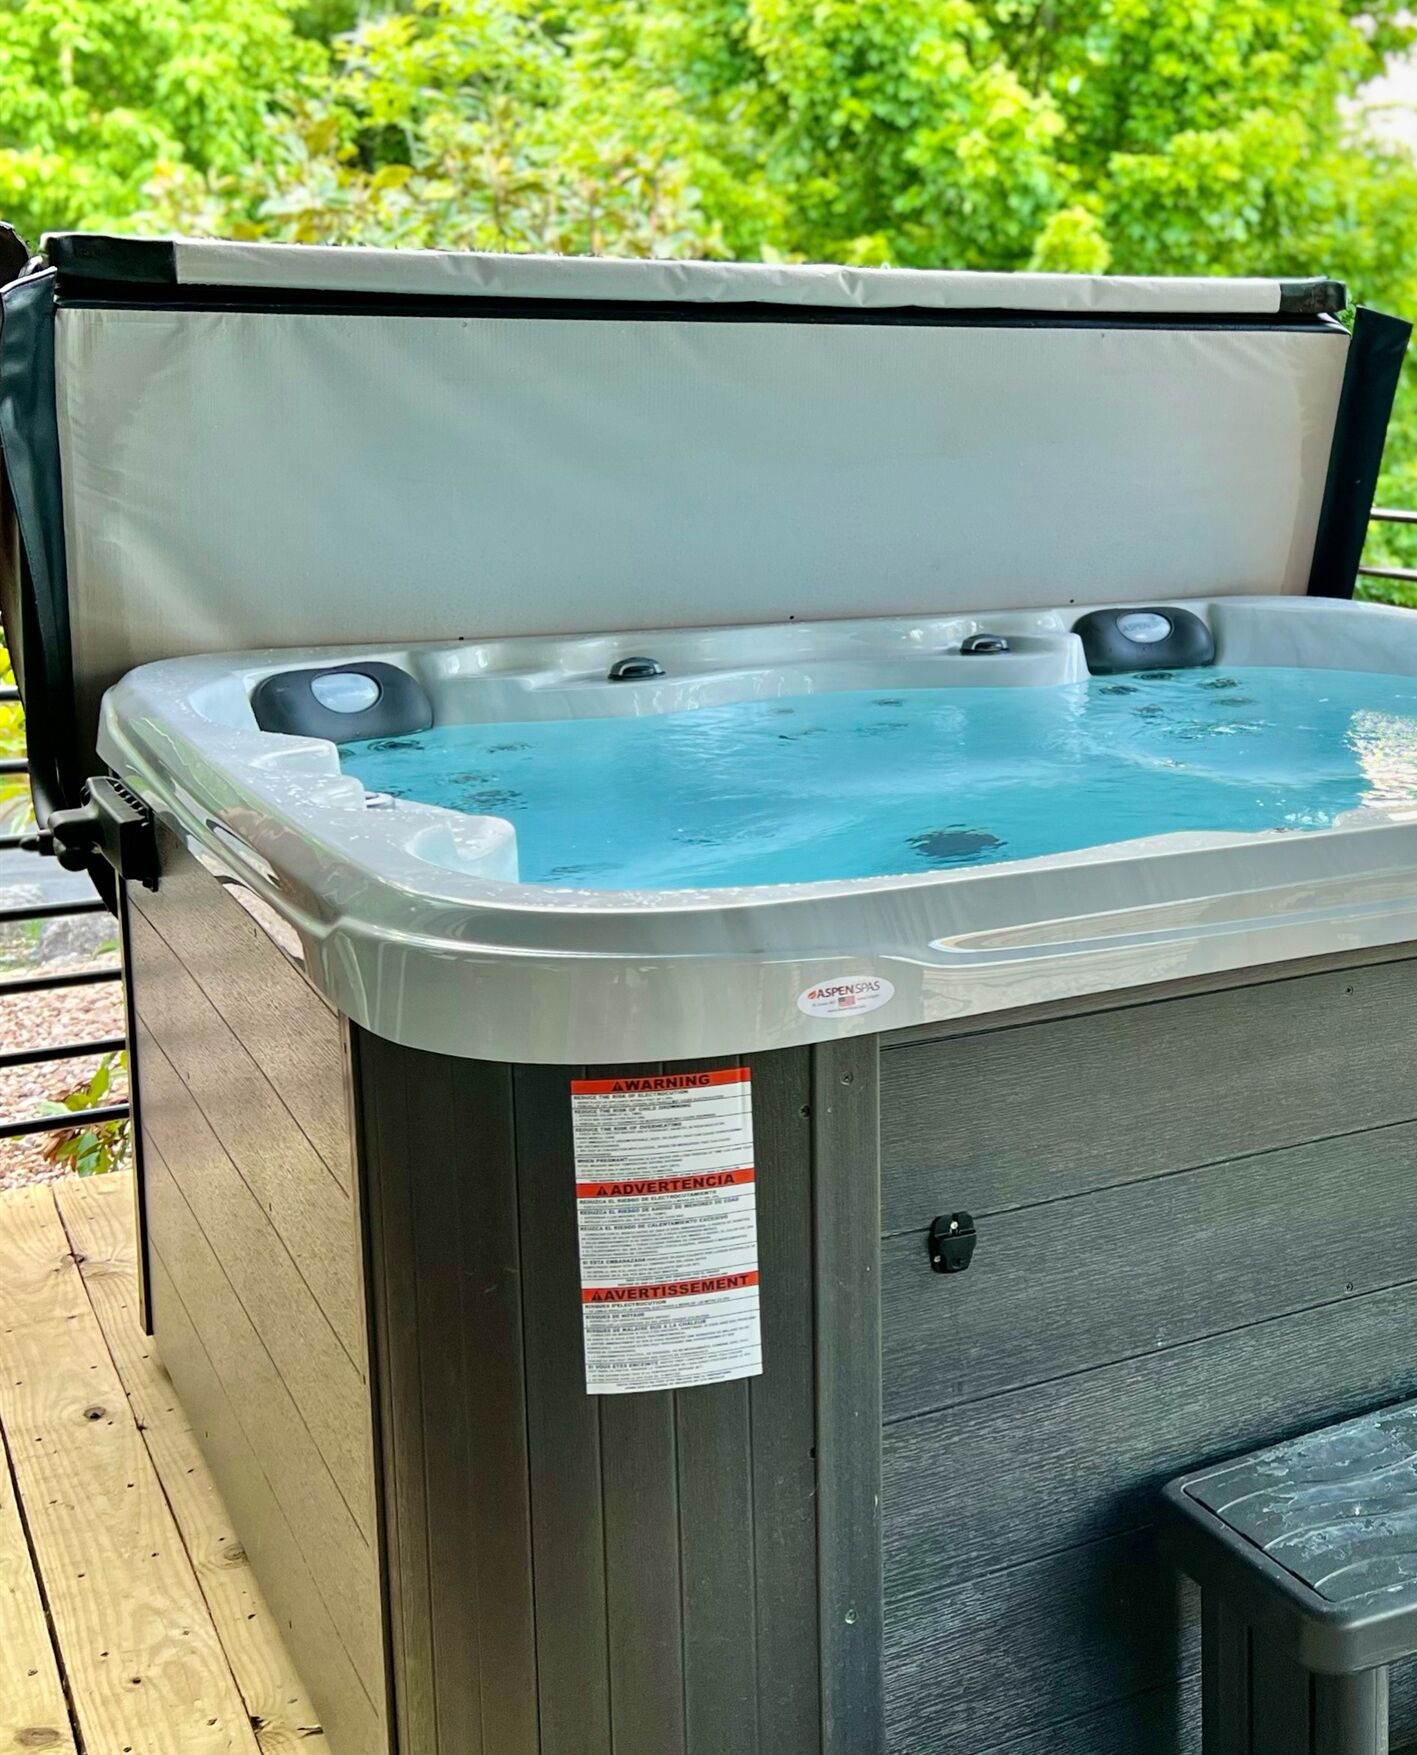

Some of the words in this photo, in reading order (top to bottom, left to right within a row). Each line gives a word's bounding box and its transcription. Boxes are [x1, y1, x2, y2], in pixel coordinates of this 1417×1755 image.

[624, 1074, 710, 1091] WARNING
[611, 1173, 735, 1195] ADVERTENCIA
[603, 1275, 749, 1301] AVERTISSEMENT
